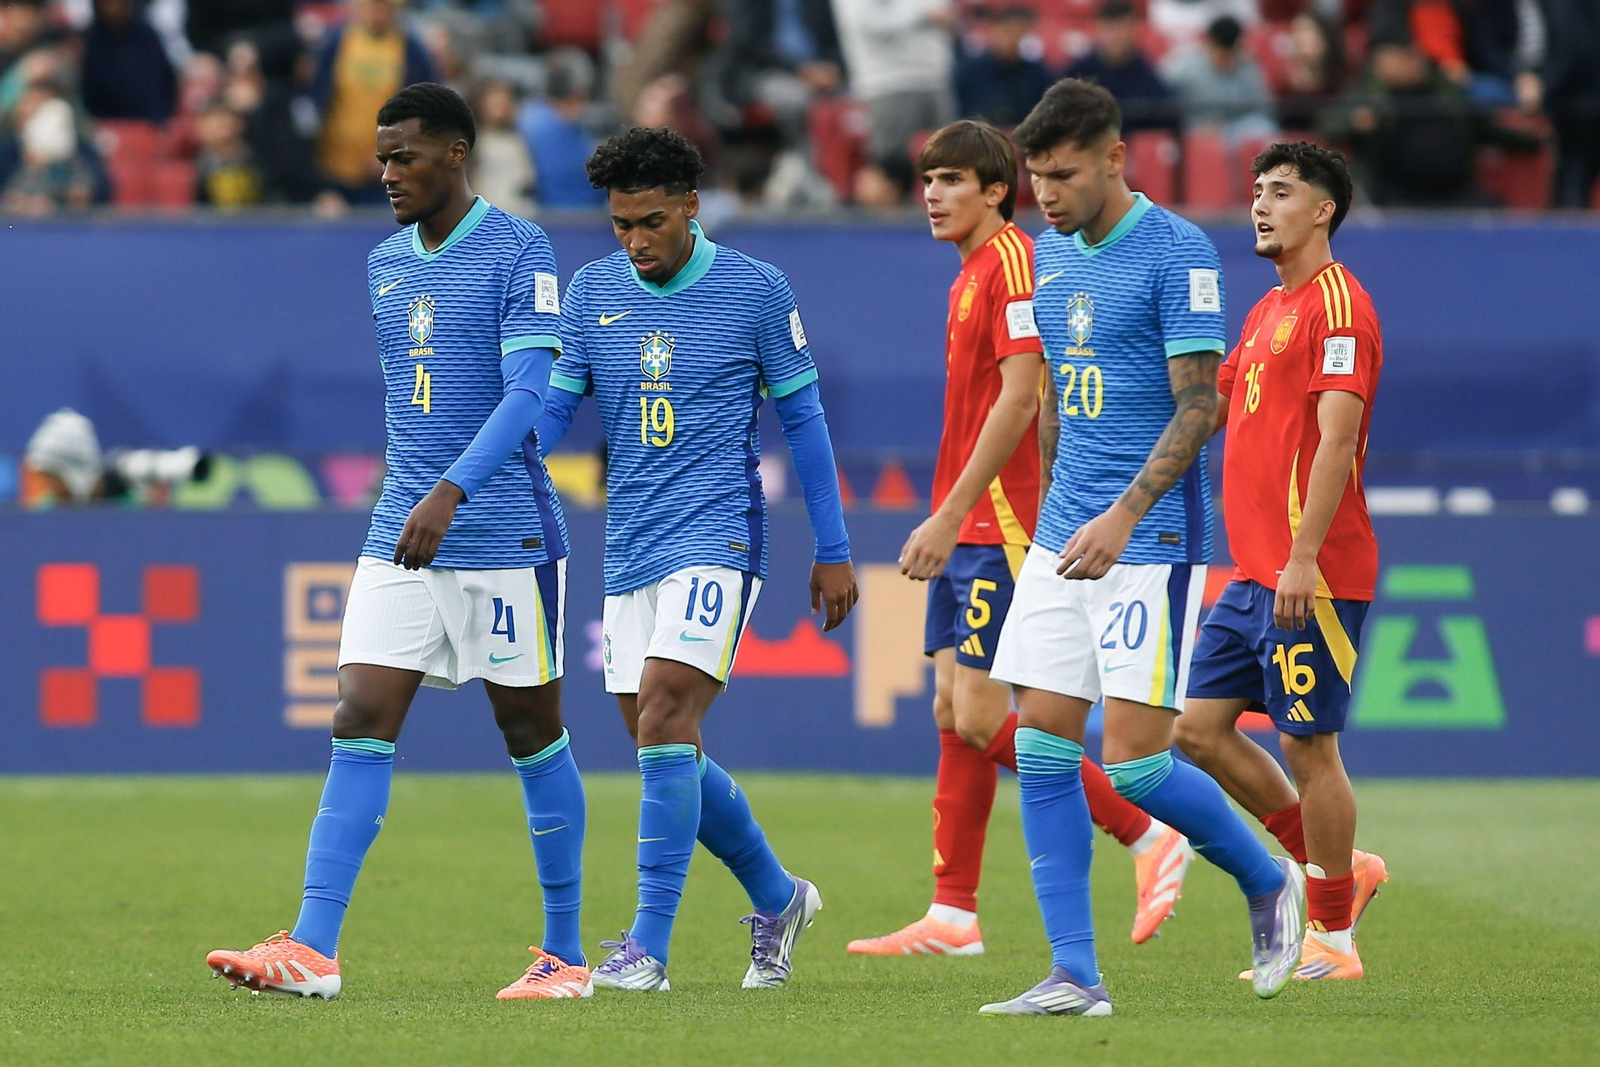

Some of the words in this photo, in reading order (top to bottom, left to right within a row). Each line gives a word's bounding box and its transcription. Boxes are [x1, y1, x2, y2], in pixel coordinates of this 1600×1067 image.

[408, 347, 435, 357] BRASIL
[1065, 346, 1096, 356] BRASIL
[410, 364, 431, 413] 4
[640, 382, 673, 390] BRASIL
[1060, 363, 1103, 418] 20
[1244, 363, 1265, 414] 16
[640, 396, 675, 447] 19
[491, 597, 516, 643] 4
[685, 577, 723, 627] 19
[966, 578, 997, 629] 5
[1100, 599, 1148, 650] 20
[1272, 643, 1317, 695] 16
